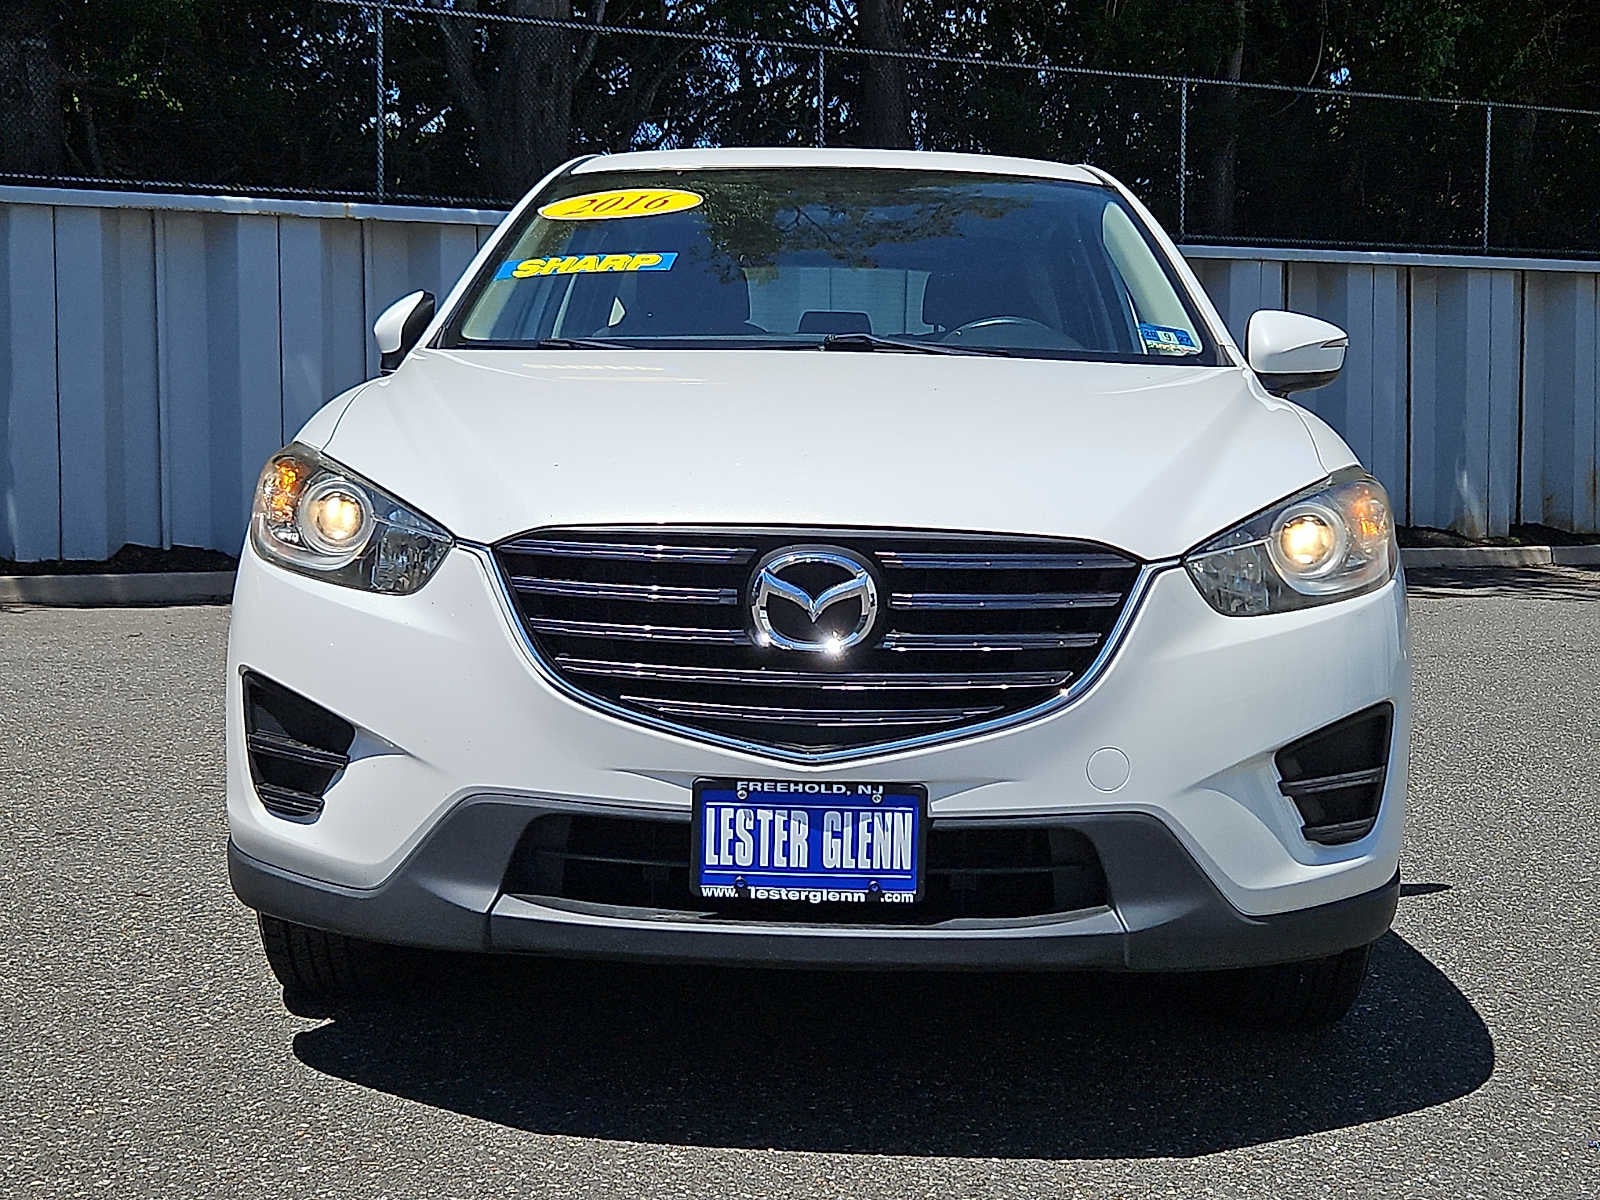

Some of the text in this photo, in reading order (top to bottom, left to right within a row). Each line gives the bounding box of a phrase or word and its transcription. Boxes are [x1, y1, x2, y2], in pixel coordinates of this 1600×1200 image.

[563, 194, 674, 215] 2016
[512, 253, 663, 279] SHARP
[1163, 332, 1172, 341] 9
[736, 781, 884, 796] FREEHOLD, NJ
[705, 807, 913, 870] LESTER GLENN
[701, 886, 914, 904] www. lesterglenn .com
